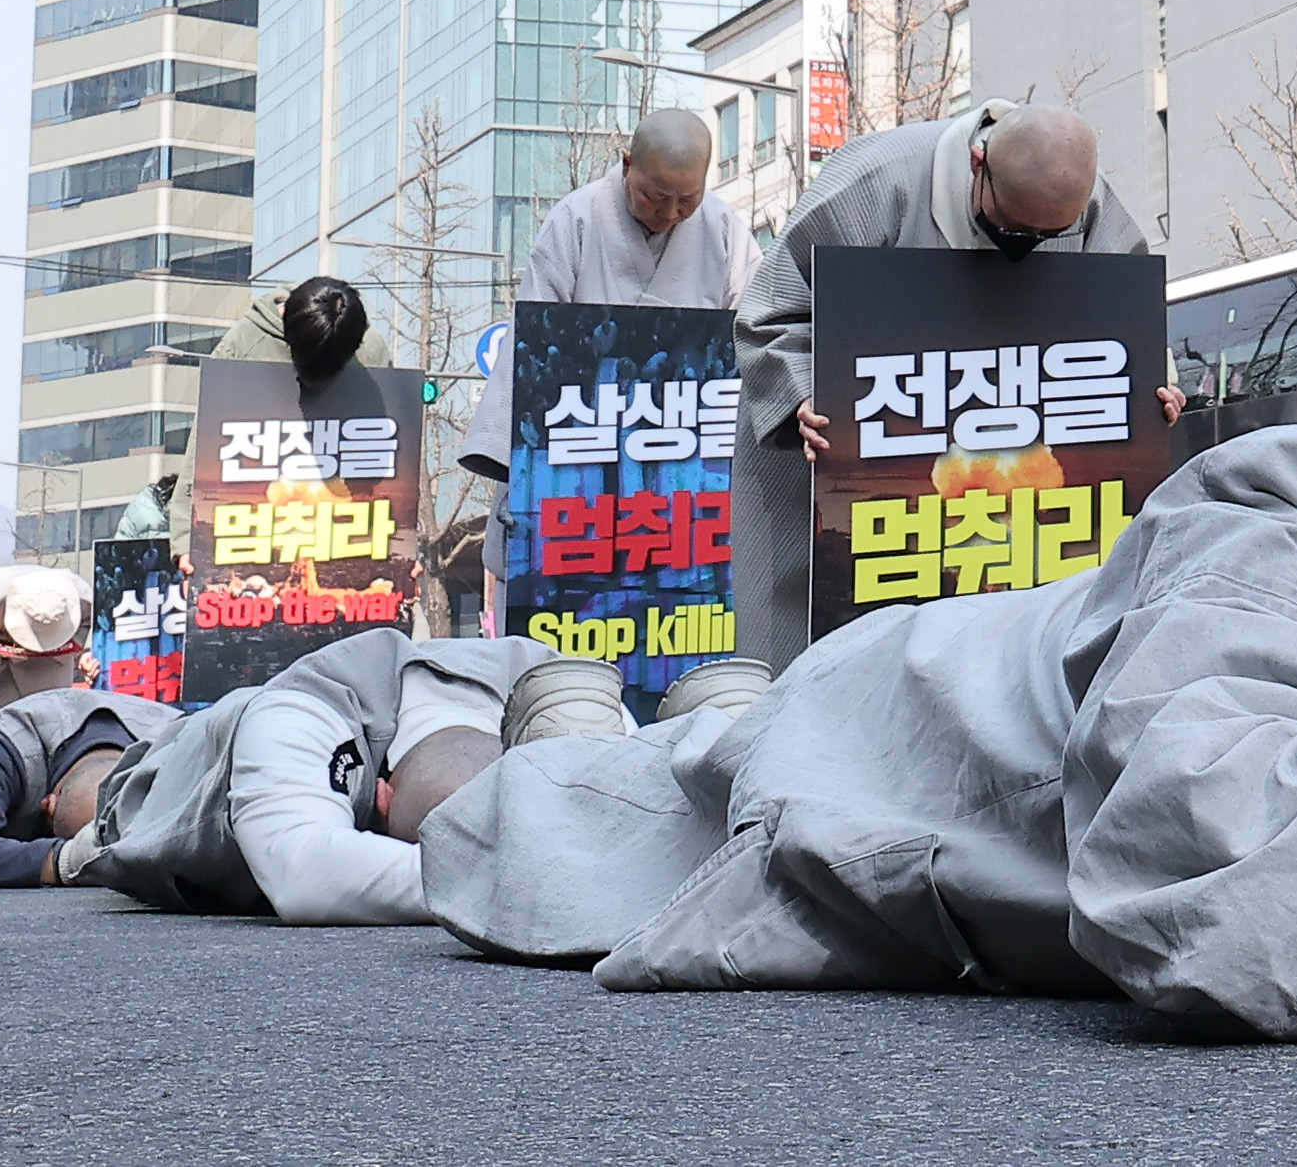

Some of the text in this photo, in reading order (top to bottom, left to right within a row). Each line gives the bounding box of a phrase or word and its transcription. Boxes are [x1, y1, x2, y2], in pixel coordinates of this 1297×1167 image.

[854, 339, 1131, 459] 전쟁을
[219, 418, 398, 482] 전쟁을
[213, 499, 396, 565] 멈춰라
[850, 479, 1133, 605] 멈춰라
[195, 589, 404, 628] Stop the war
[528, 611, 635, 662] Stop
